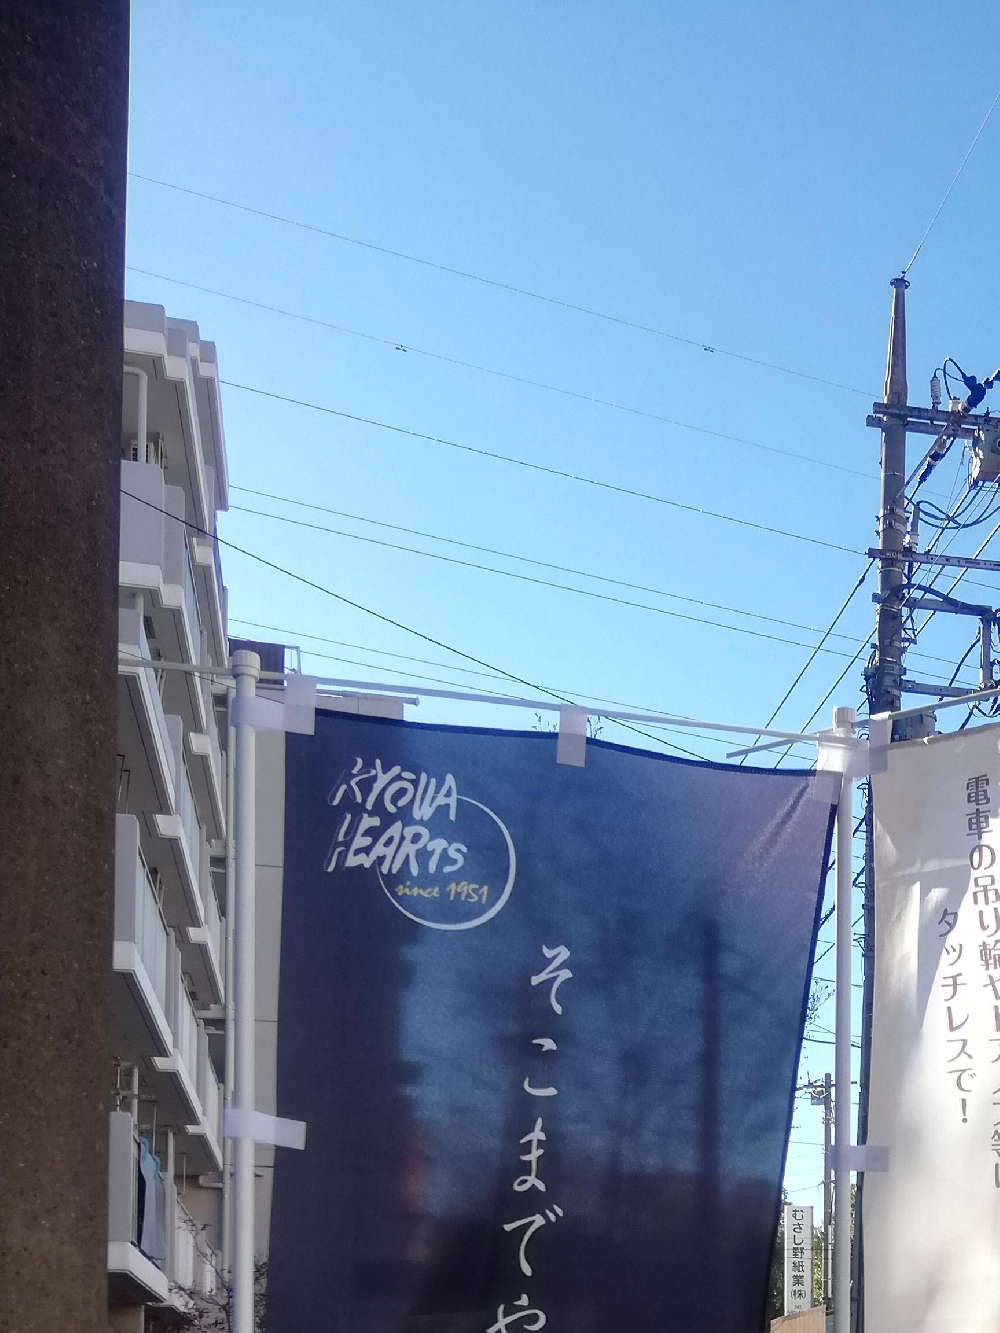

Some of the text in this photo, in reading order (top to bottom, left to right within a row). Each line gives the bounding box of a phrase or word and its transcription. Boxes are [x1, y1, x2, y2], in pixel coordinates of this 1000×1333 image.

[395, 880, 490, 904] since 1951
[937, 907, 976, 1124] タッチレスで！
